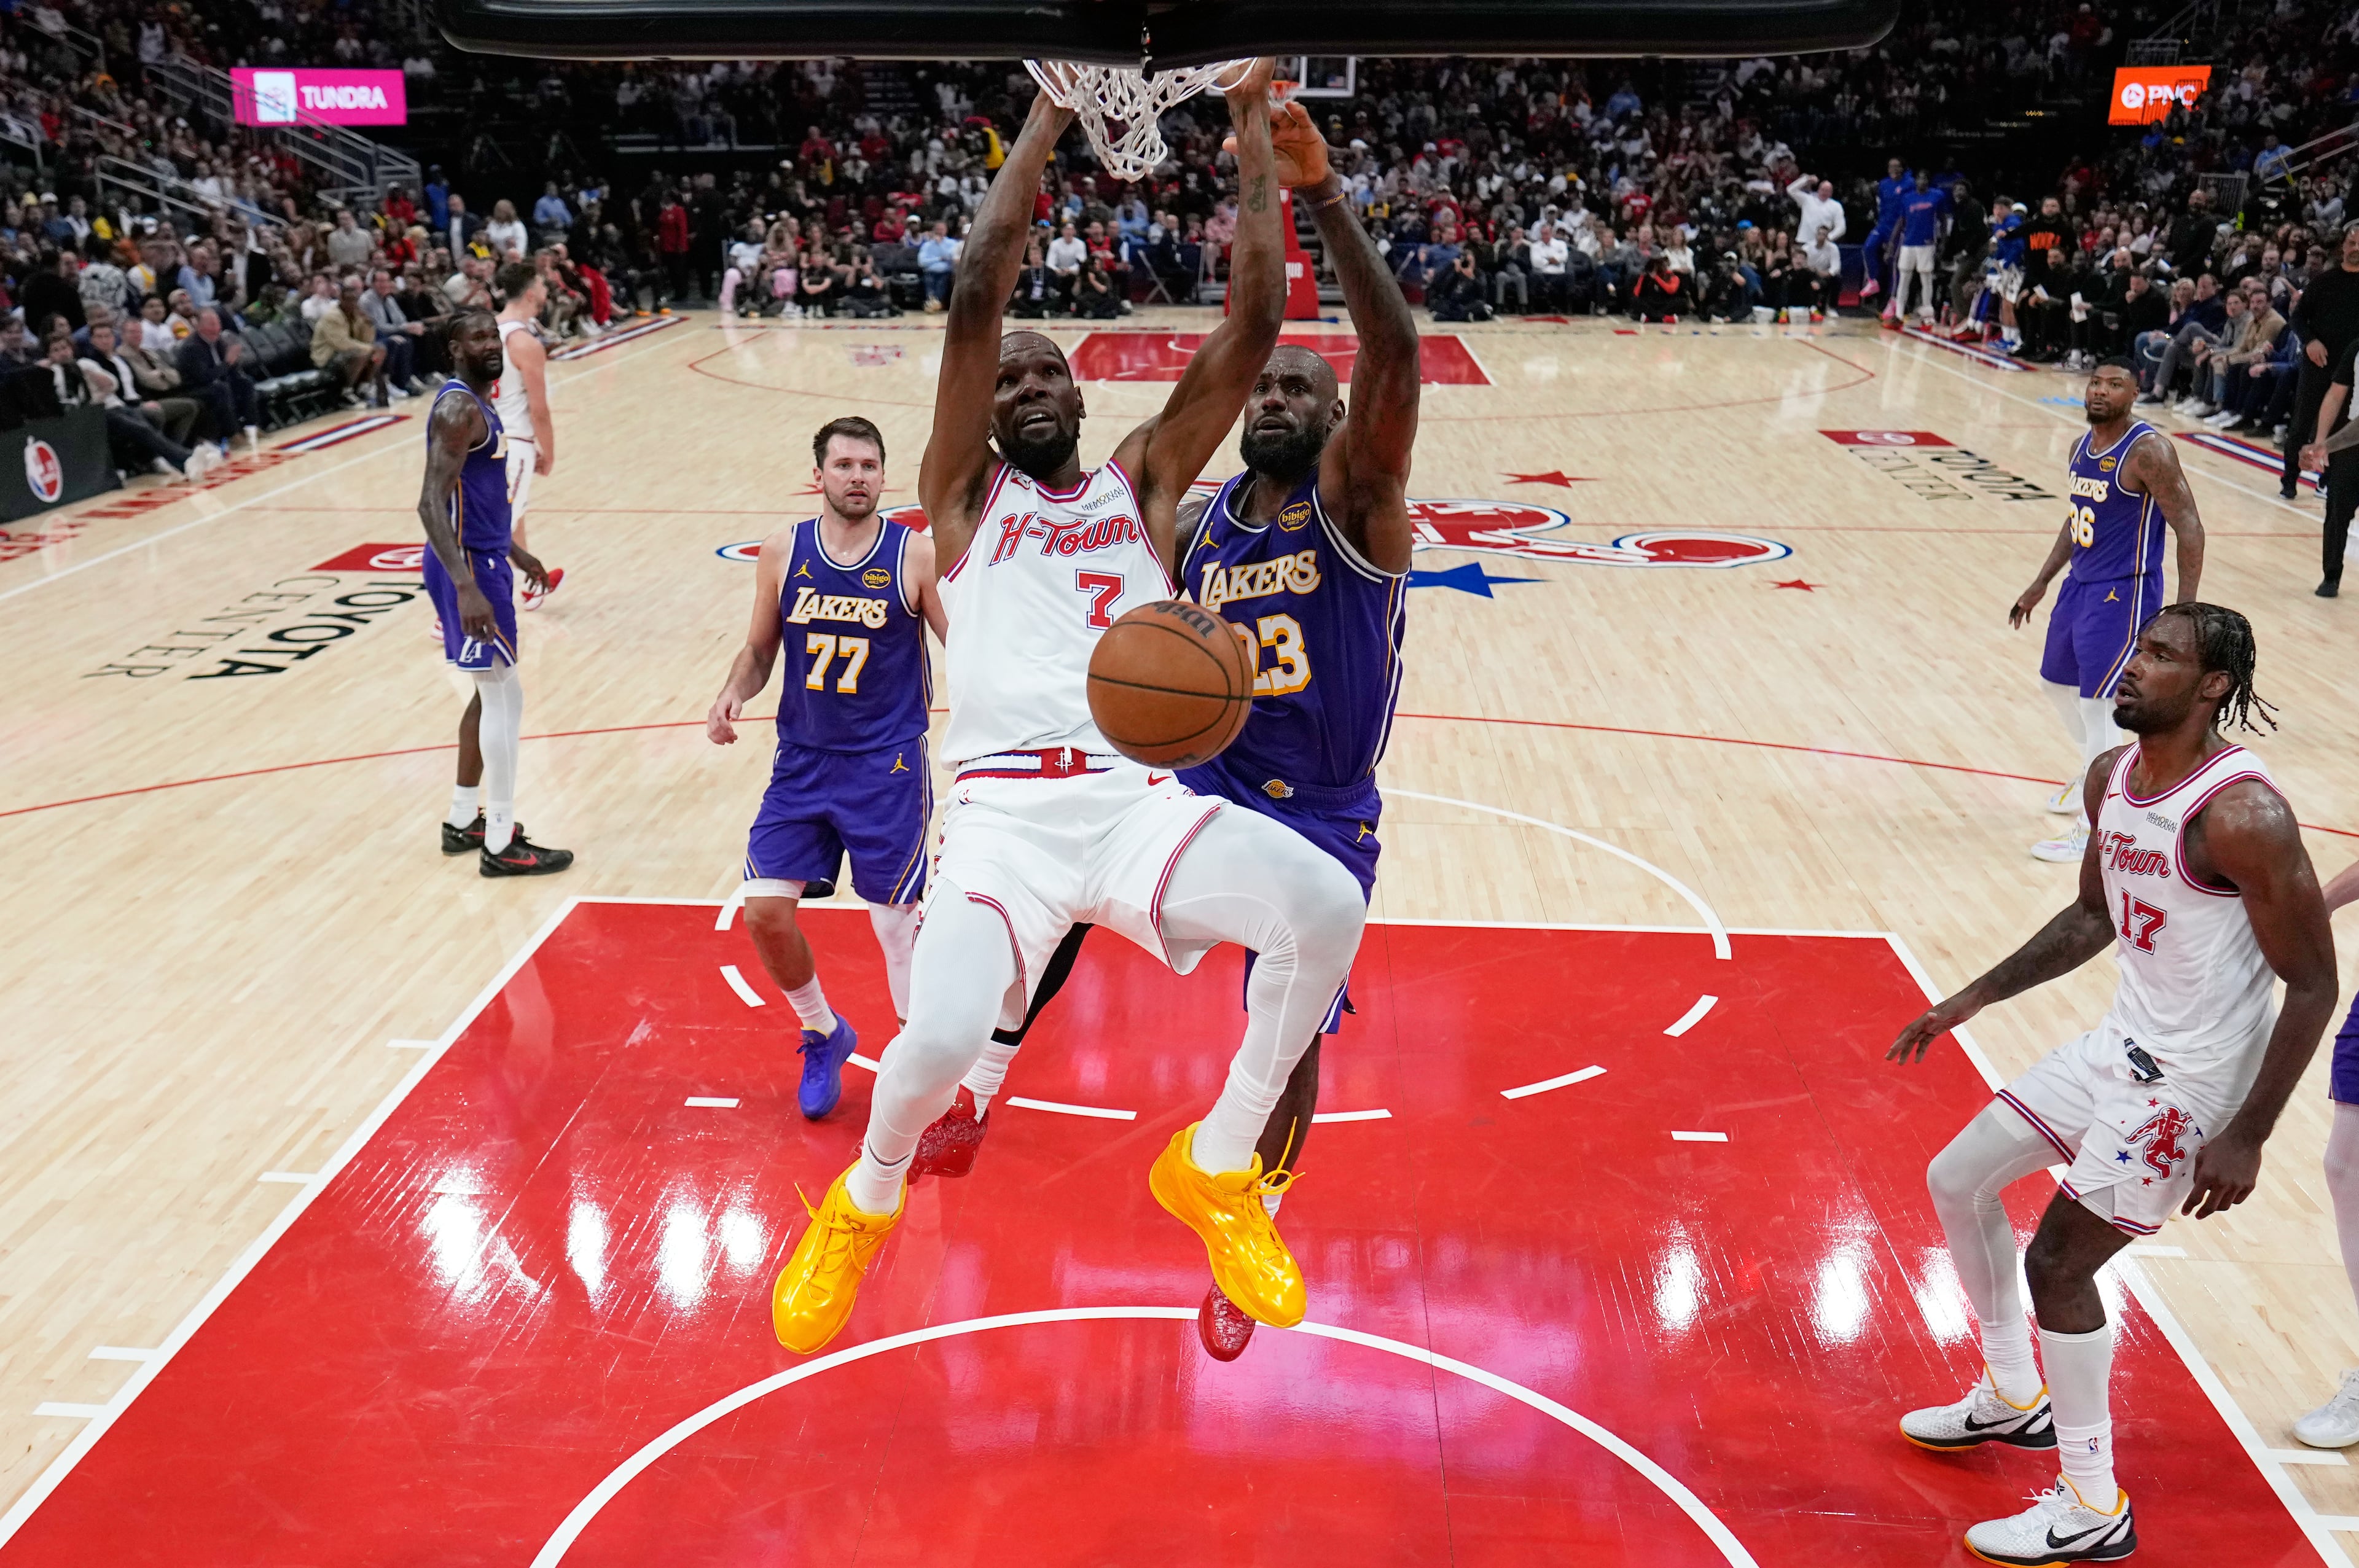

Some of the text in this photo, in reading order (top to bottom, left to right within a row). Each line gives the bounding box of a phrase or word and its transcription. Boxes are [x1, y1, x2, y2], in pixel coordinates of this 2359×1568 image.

[300, 85, 388, 109] TUNDRA
[2147, 84, 2196, 106] PNC
[988, 511, 1140, 567] H-Town
[1281, 509, 1310, 523] bibigo
[864, 574, 888, 583] bibigo
[1076, 569, 1125, 631] 7
[1200, 549, 1321, 614] LAKERS
[80, 575, 341, 679] CENTER
[786, 587, 889, 630] LAKERS
[805, 632, 870, 695] 77
[2146, 810, 2178, 829] MEMORIAL
[2119, 887, 2167, 956] 17
